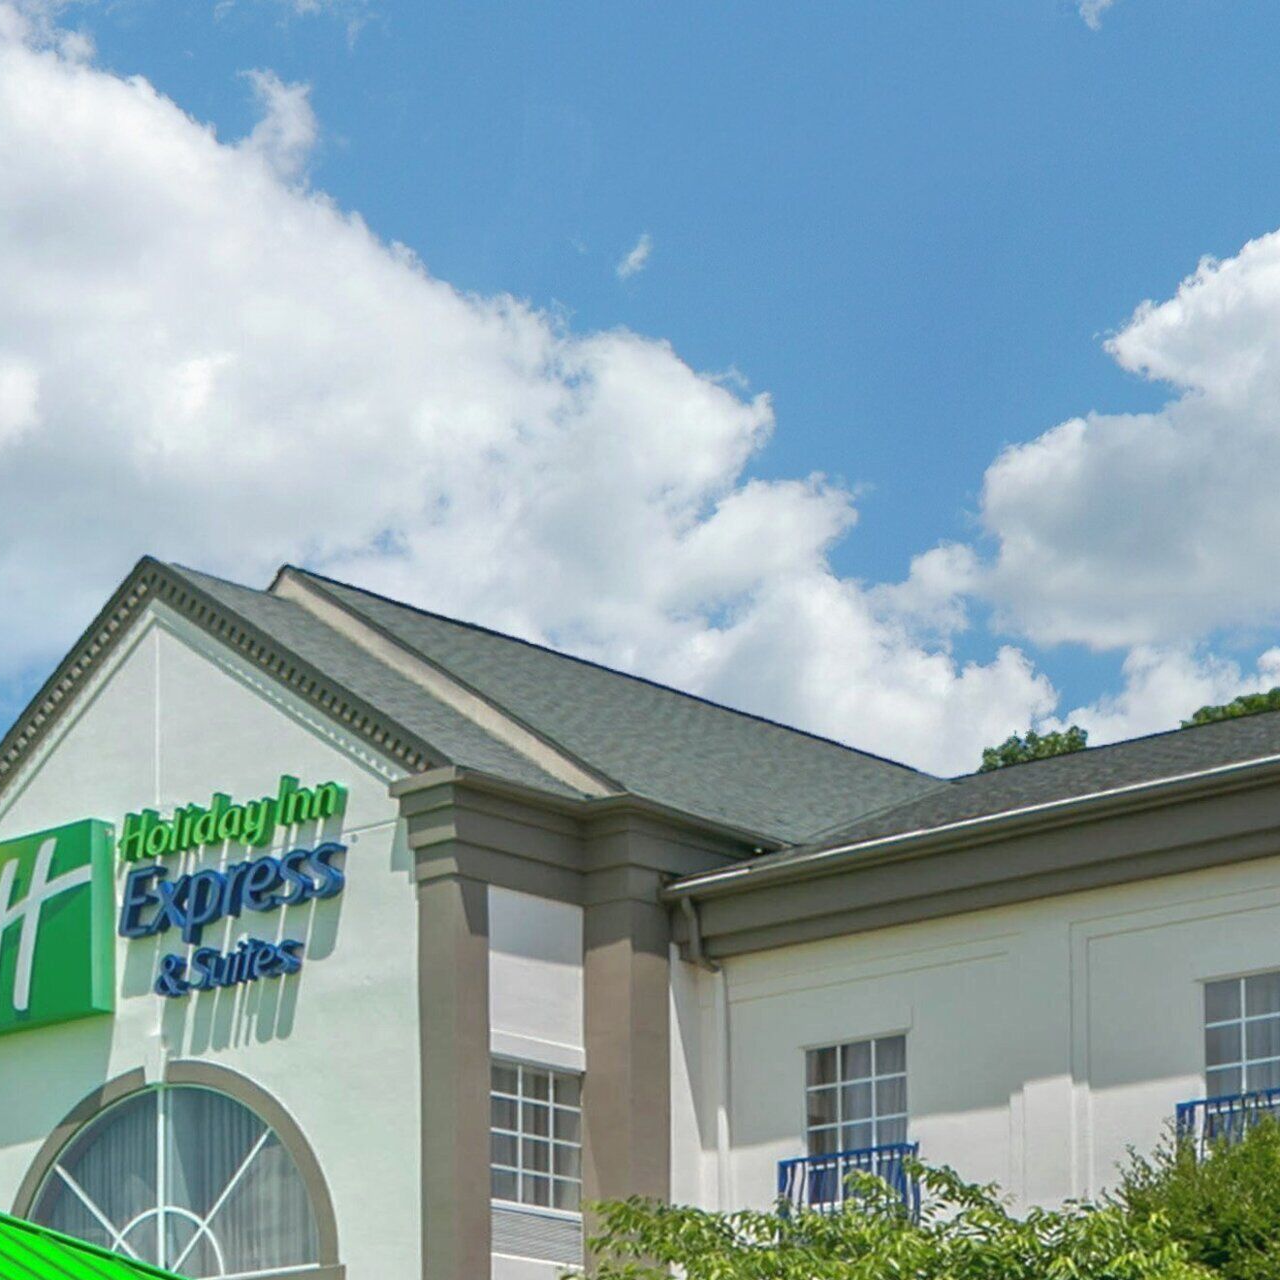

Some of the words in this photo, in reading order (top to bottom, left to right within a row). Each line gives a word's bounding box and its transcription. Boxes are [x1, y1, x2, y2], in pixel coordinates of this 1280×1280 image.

[119, 792, 277, 862] Holiday
[275, 774, 348, 826] Inn
[118, 841, 348, 946] Express
[155, 953, 191, 998] &
[188, 937, 304, 991] Suites
